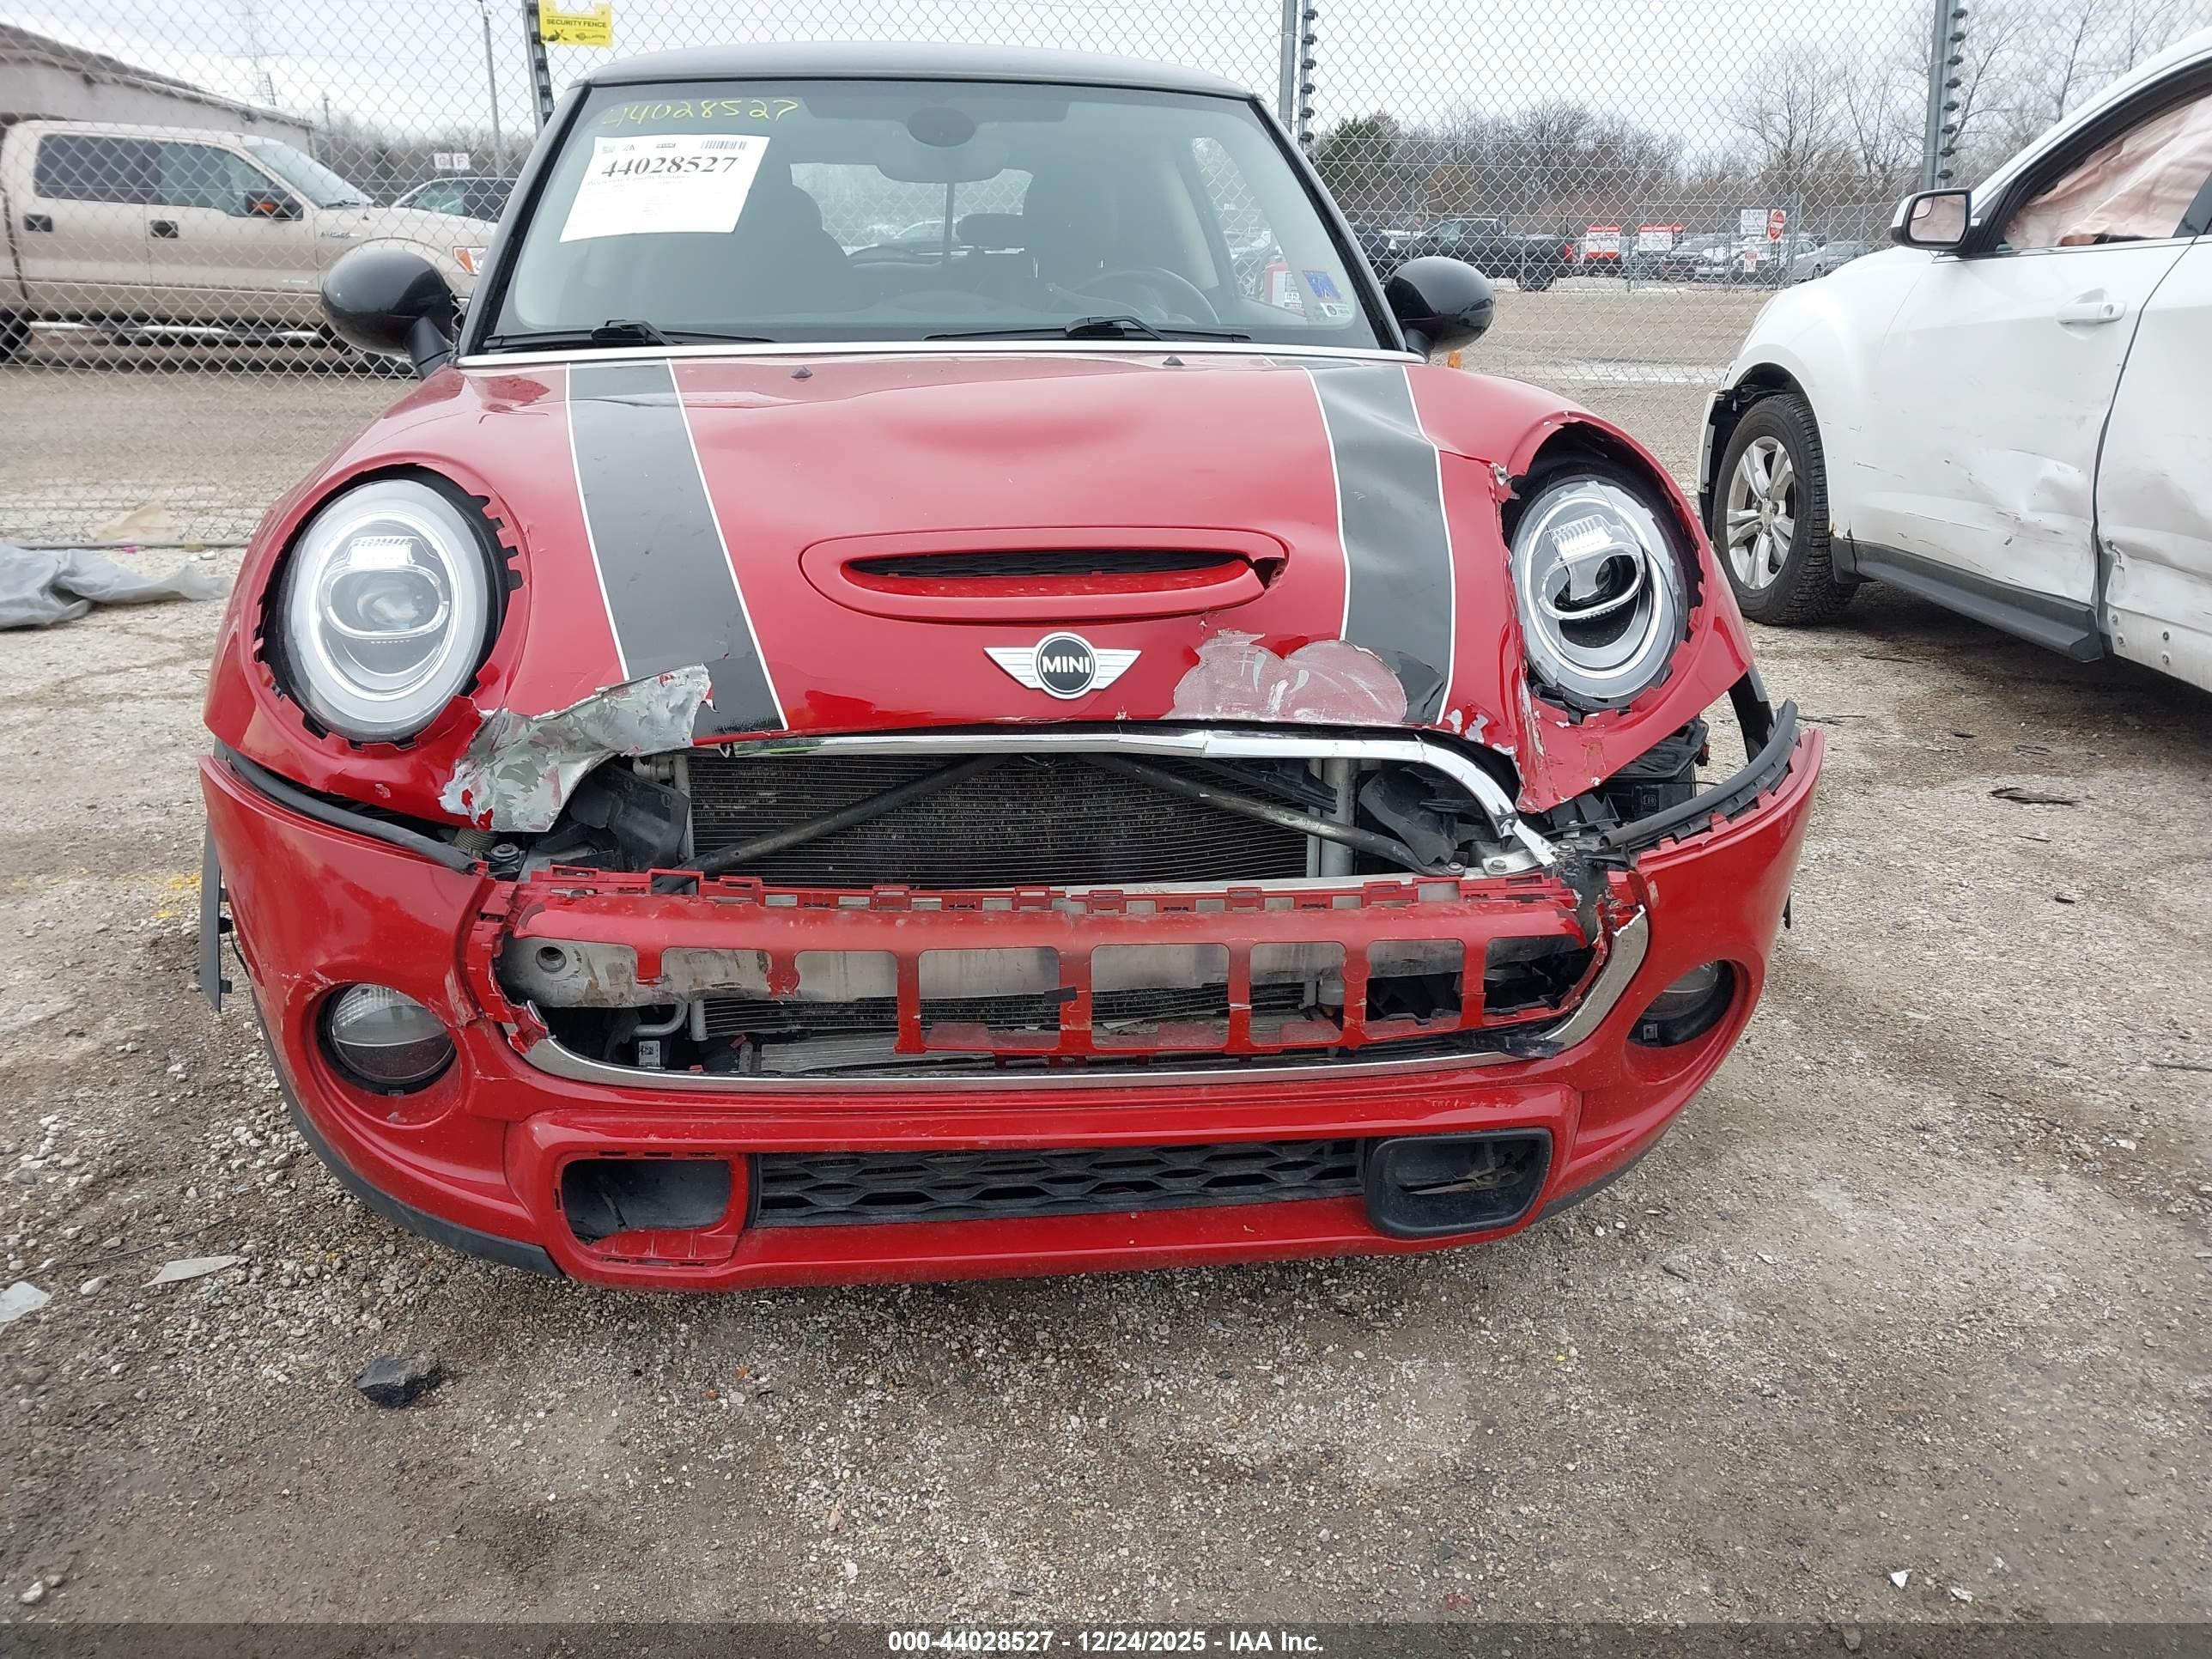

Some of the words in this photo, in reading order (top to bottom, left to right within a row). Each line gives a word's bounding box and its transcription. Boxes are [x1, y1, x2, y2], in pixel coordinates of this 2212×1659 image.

[546, 18, 582, 27] SECURITY
[602, 100, 799, 127] 44028527
[601, 155, 738, 178] 44028527
[1042, 656, 1091, 673] MINI
